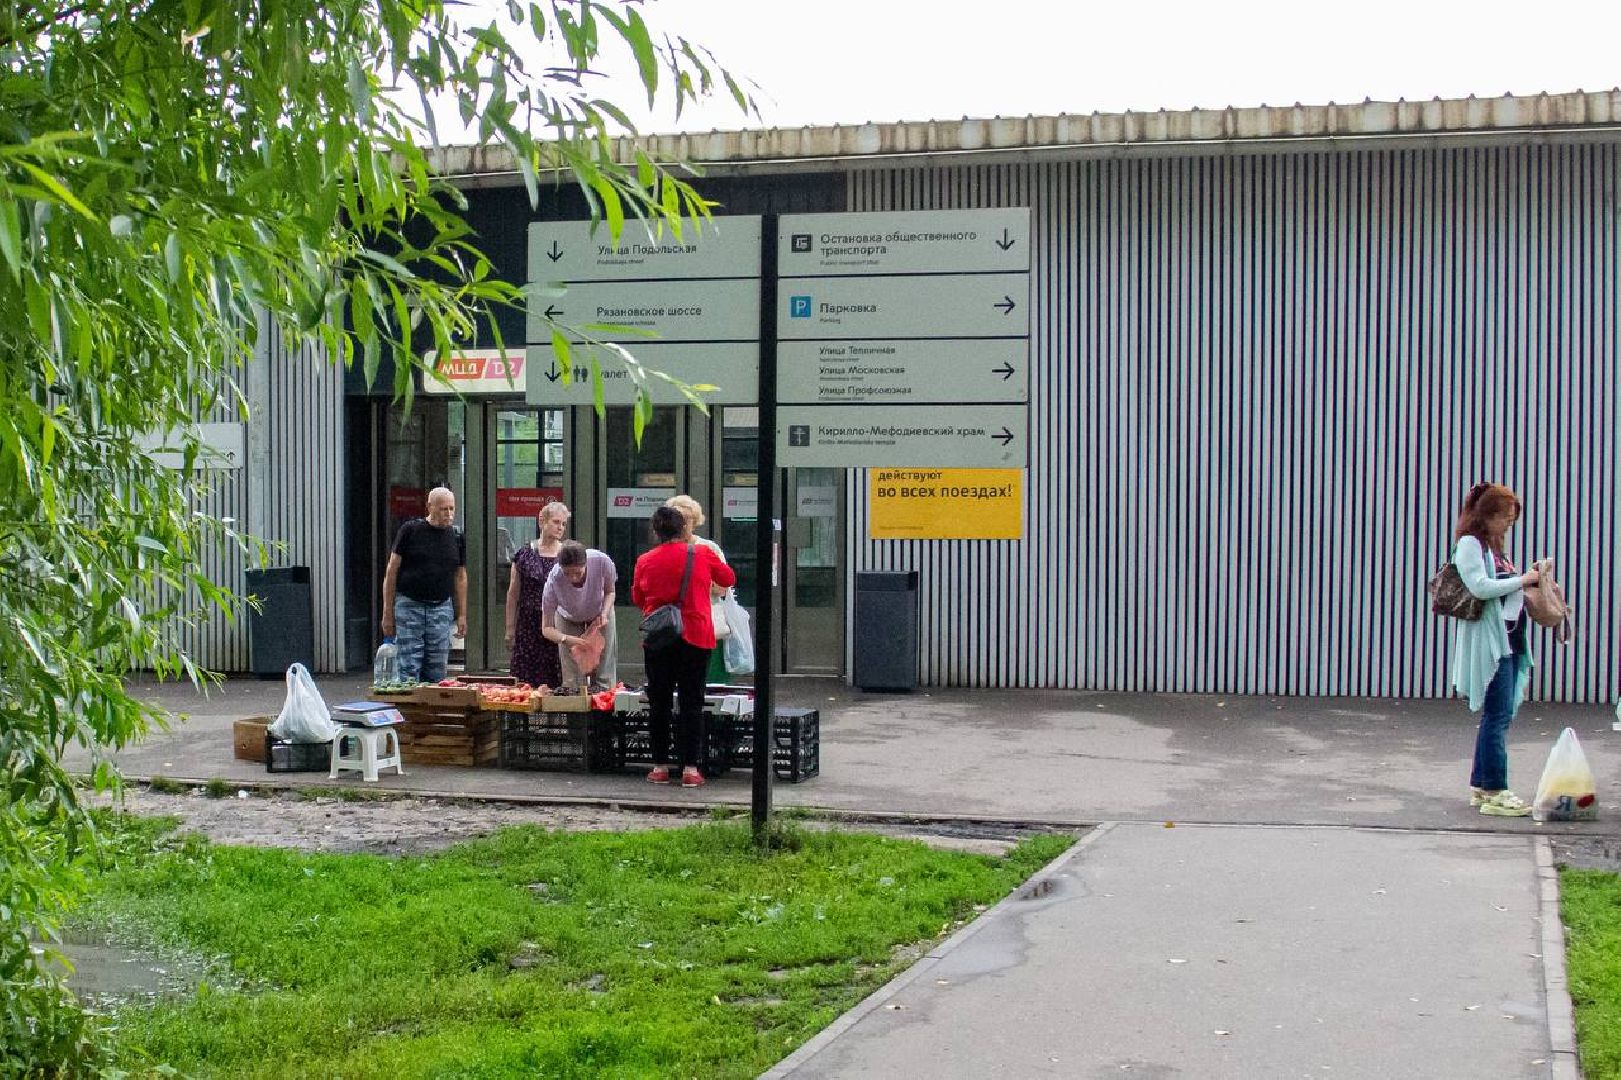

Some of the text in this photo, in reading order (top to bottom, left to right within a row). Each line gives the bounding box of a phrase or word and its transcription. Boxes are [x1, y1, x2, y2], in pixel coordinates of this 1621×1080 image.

[820, 231, 977, 244] Остановка общественного
[633, 244, 697, 255] Подольская
[820, 245, 887, 258] транспорта
[597, 306, 702, 317] Рязановское шоссе
[819, 302, 877, 314] Парковка
[819, 347, 846, 355] Улица
[597, 369, 629, 379] алет
[819, 366, 906, 375] Улица Московская
[818, 385, 912, 396] Улица Профсоюзная
[818, 426, 986, 438] Кирилло-Мефодиевский храм
[877, 470, 942, 482] действуют
[877, 483, 1012, 500] во всех поездах!
